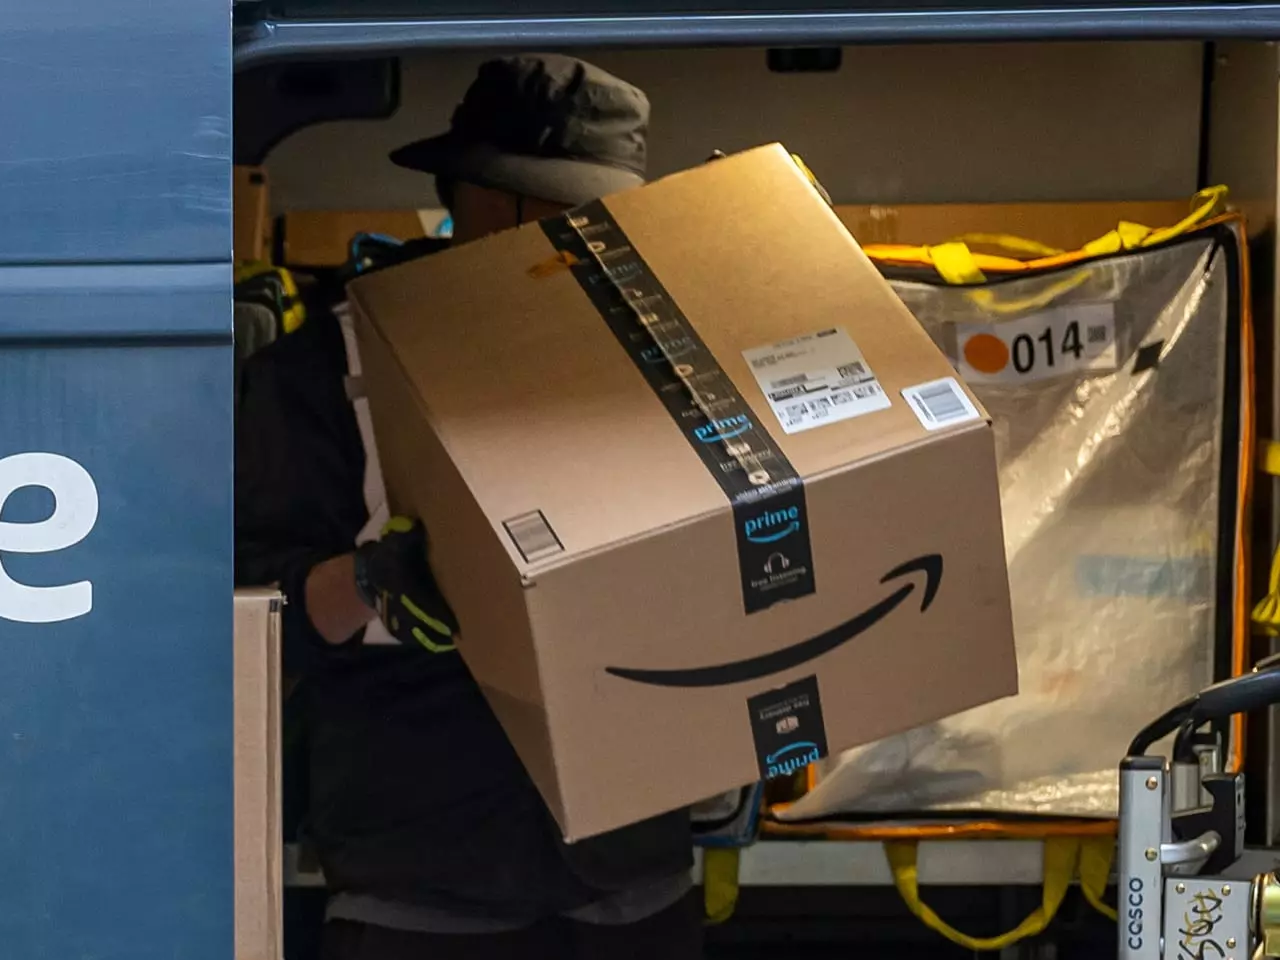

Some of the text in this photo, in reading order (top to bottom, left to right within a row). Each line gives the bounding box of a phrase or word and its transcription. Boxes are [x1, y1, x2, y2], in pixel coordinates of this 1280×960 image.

[1011, 320, 1084, 374] 014
[693, 413, 747, 440] prime
[744, 505, 799, 537] prime
[765, 747, 819, 779] prime
[1128, 877, 1143, 950] COSCO
